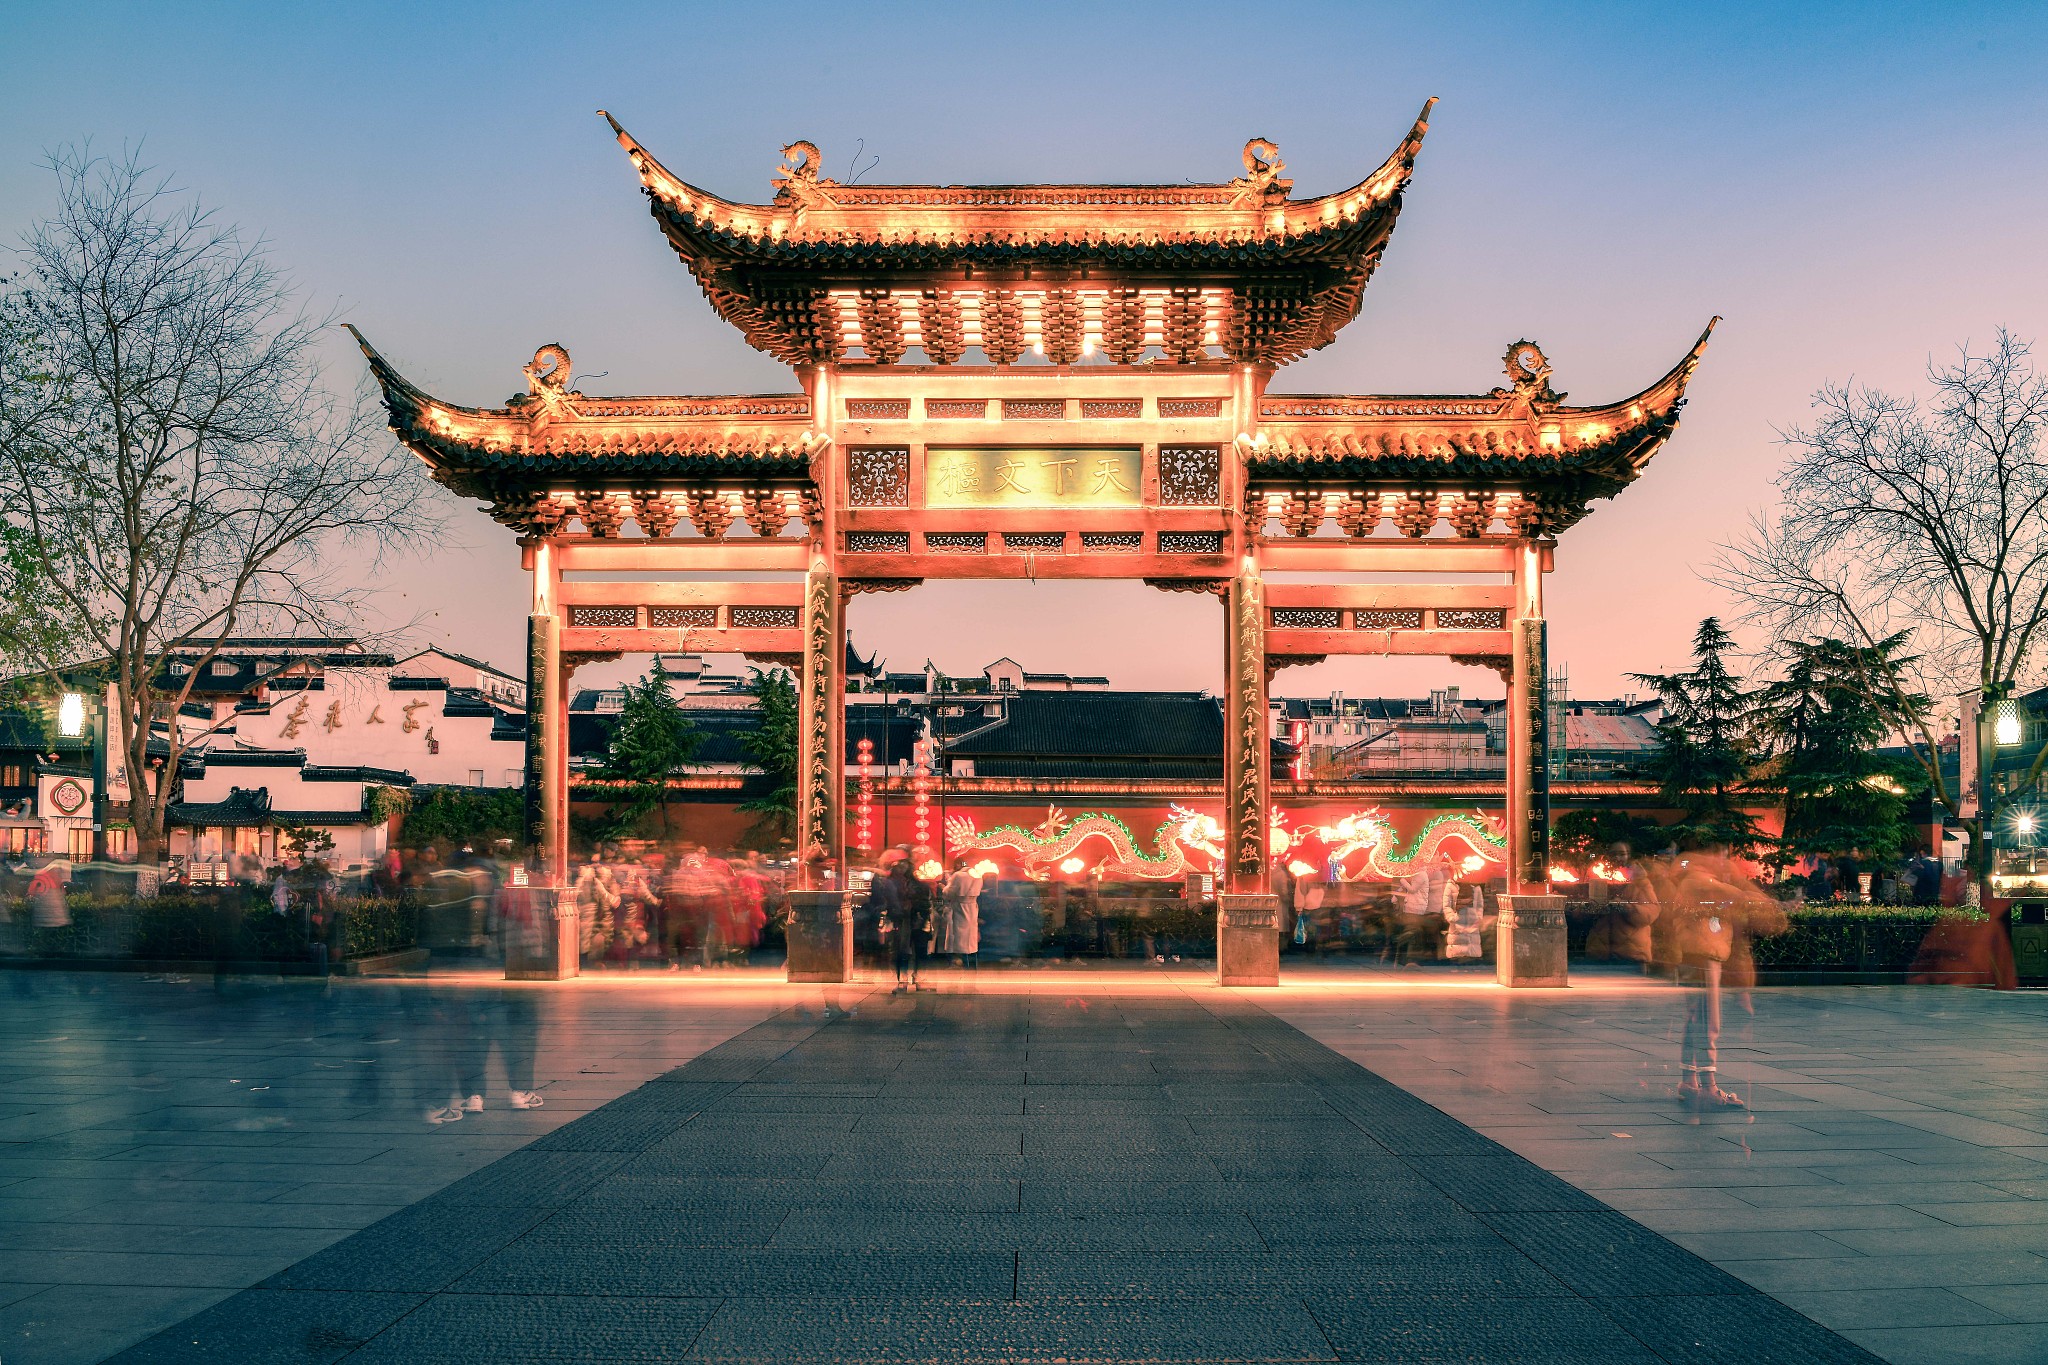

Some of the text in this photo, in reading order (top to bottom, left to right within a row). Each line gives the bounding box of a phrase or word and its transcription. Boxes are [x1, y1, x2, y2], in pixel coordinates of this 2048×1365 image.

[936, 458, 1132, 496] 天下文樞
[279, 695, 430, 740] 秦淮人家
